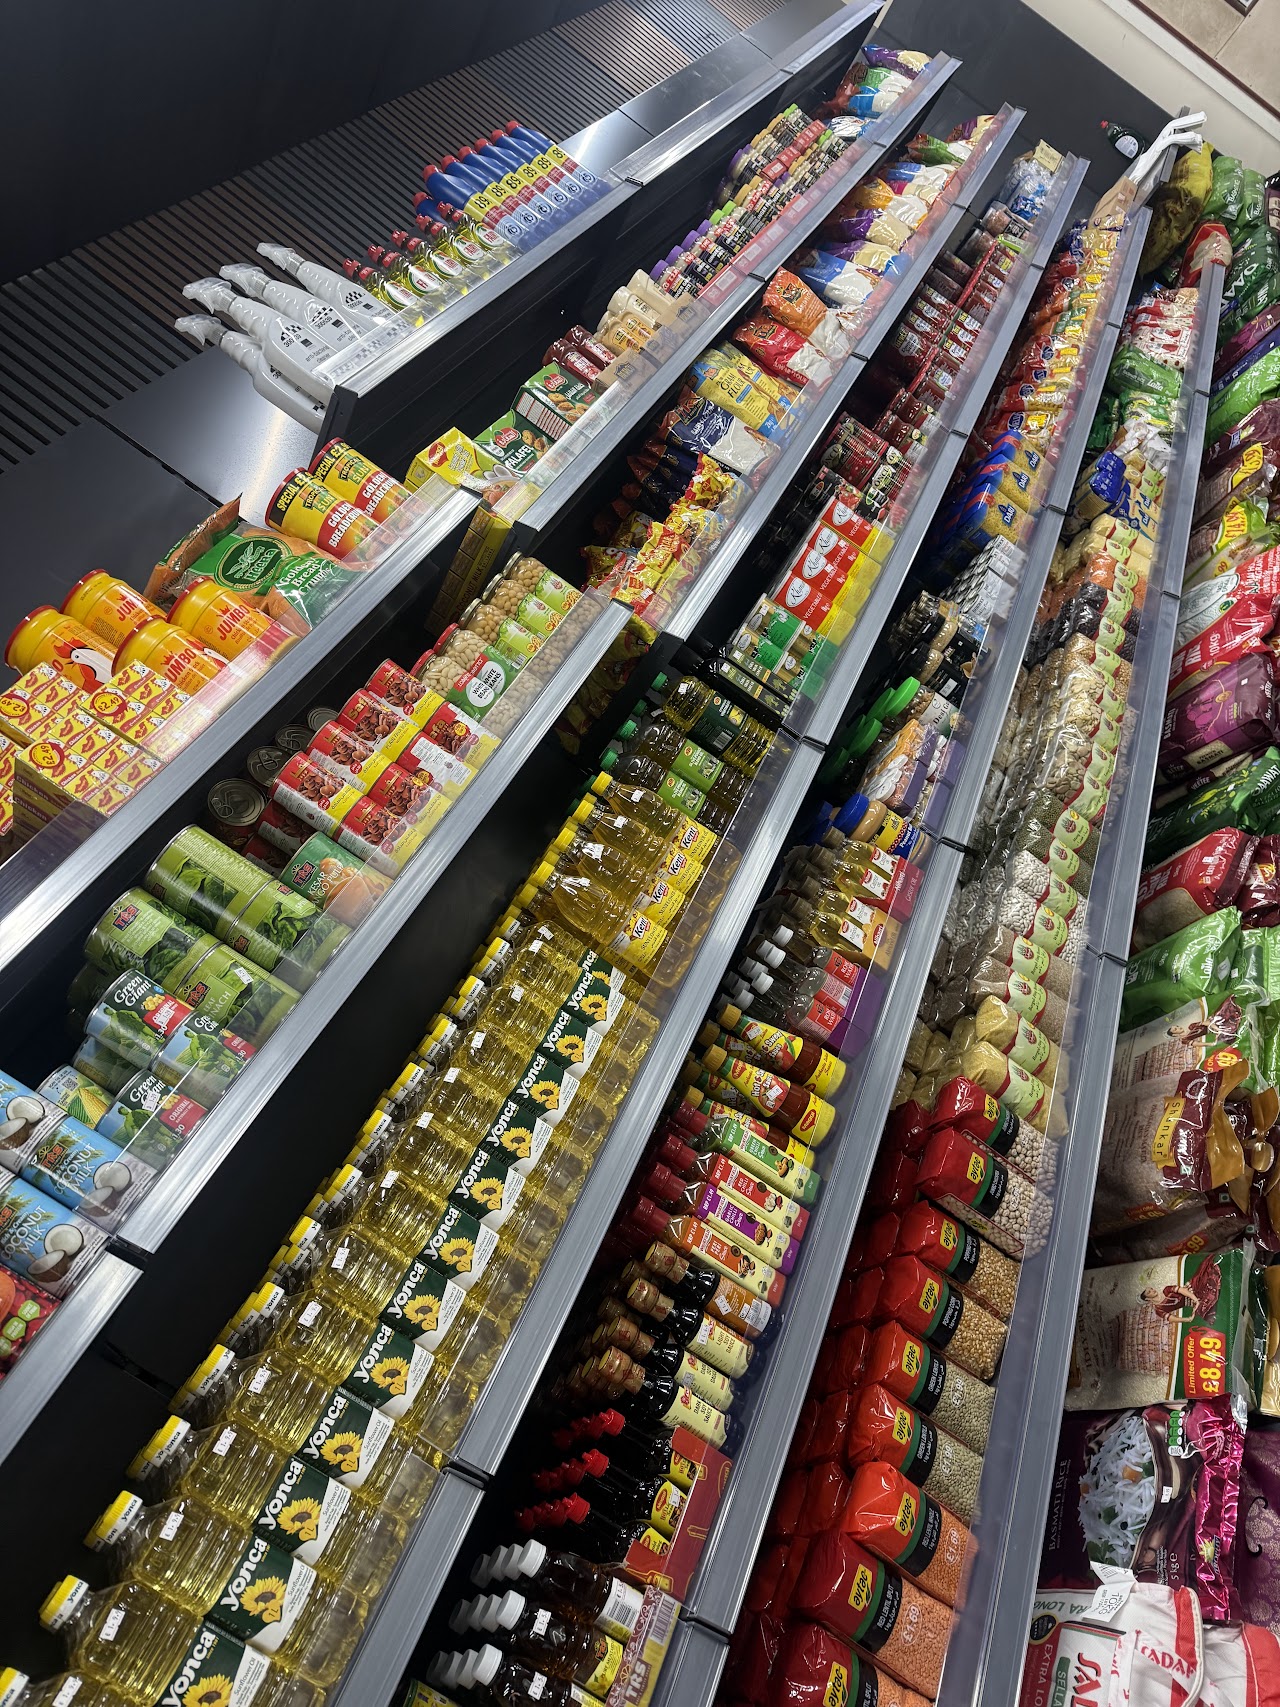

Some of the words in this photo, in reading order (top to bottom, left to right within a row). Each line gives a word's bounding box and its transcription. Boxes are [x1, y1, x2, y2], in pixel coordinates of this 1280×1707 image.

[523, 166, 538, 177] 89
[538, 157, 552, 169] 89
[491, 183, 507, 197] 89
[506, 176, 521, 189] 89
[720, 371, 736, 391] GRAM
[728, 377, 745, 399] FLOUR
[1147, 379, 1164, 392] Laila
[505, 444, 535, 472] FALAFEL
[352, 466, 369, 481] SUN
[277, 484, 299, 511] SPECIAL
[318, 494, 336, 510] SUN
[244, 549, 280, 582] Heena
[280, 557, 314, 587] Golden
[292, 563, 321, 586] Bread
[472, 566, 484, 584] MILK
[219, 604, 250, 641] JUMBO
[1209, 631, 1221, 656] 10kg
[164, 648, 197, 684] UMBO
[483, 668, 498, 685] WHITE
[34, 684, 48, 696] Chicken
[99, 697, 119, 712] £2.49
[27, 720, 42, 733] Chicken
[932, 715, 946, 725] Desi
[1164, 708, 1177, 740] BASMATI
[69, 732, 85, 745] Chicken
[42, 745, 55, 765] £2.49
[17, 776, 48, 800] Chicken
[1190, 776, 1211, 790] VEETEE
[681, 825, 700, 851] Kent
[900, 834, 911, 848] Peanut
[293, 863, 313, 885] TRS
[668, 853, 686, 877] Kent
[308, 871, 328, 896] KESAR
[652, 882, 670, 903] Kent
[115, 907, 138, 927] TRS
[633, 914, 652, 940] Kent
[1200, 955, 1212, 980] Laila
[114, 976, 143, 1004] Green
[124, 980, 152, 1007] Giant
[567, 970, 595, 1011] yonca
[203, 997, 216, 1010] LEAF
[208, 990, 231, 1020] INACH
[542, 1010, 571, 1052] yonca
[766, 1032, 783, 1046] Sweet
[769, 1044, 781, 1057] Sauce
[130, 1076, 157, 1102] Green
[516, 1054, 547, 1099] yonca
[750, 1082, 761, 1097] Hot
[169, 1101, 190, 1122] ORIGINAL
[986, 1097, 999, 1119] aytac
[486, 1100, 518, 1148] yonca
[1155, 1101, 1180, 1158] Shankar
[42, 1144, 63, 1169] TRS
[53, 1143, 96, 1196] COCONUT
[969, 1154, 985, 1182] aytac
[71, 1163, 96, 1192] MILK
[454, 1148, 489, 1200] yonca
[724, 1205, 734, 1221] GARLIC
[729, 1209, 737, 1224] CHILLI
[2, 1205, 47, 1260] COCONUT
[21, 1225, 46, 1255] MILK
[423, 1206, 460, 1261] yonca
[942, 1222, 955, 1248] aytac
[266, 1290, 279, 1310] yonca
[387, 1259, 425, 1319] yonca
[922, 1282, 938, 1310] aytac
[942, 1307, 953, 1327] POPPING
[716, 1330, 725, 1346] LIGHT
[722, 1338, 730, 1349] SOY
[725, 1338, 736, 1354] SAUCE
[352, 1323, 393, 1384] yonca
[904, 1344, 919, 1375] aytac
[1200, 1337, 1221, 1393] £8.49
[928, 1375, 936, 1392] GREEN
[932, 1359, 940, 1376] LENTILS
[694, 1399, 702, 1415] DARK
[704, 1407, 713, 1423] SAUCE
[302, 1392, 347, 1461] yonca
[897, 1409, 911, 1443] aytac
[166, 1431, 181, 1451] yonca
[362, 1427, 376, 1453] Sunflower
[347, 1459, 355, 1468] 1L
[1056, 1459, 1067, 1489] RICE
[258, 1458, 305, 1532] yonca
[322, 1494, 335, 1522] Sunflower
[121, 1499, 138, 1522] yonca
[898, 1498, 916, 1534] aytac
[1049, 1490, 1066, 1551] BASMATI
[305, 1527, 313, 1538] 1L
[946, 1528, 959, 1563] £1.69
[219, 1536, 268, 1613] yonca
[288, 1570, 301, 1598] Sunflower
[852, 1570, 870, 1607] aytac
[266, 1610, 275, 1622] 1L
[877, 1615, 885, 1628] RED
[881, 1596, 891, 1616] LENTIL
[887, 1583, 895, 1598] SPLIT
[903, 1604, 919, 1643] £1.69
[1038, 1645, 1053, 1685] EXTRA
[234, 1668, 251, 1696] Sunflower
[626, 1662, 649, 1698] TRS
[826, 1667, 845, 1707] aytac
[1052, 1670, 1067, 1707] SELLA
